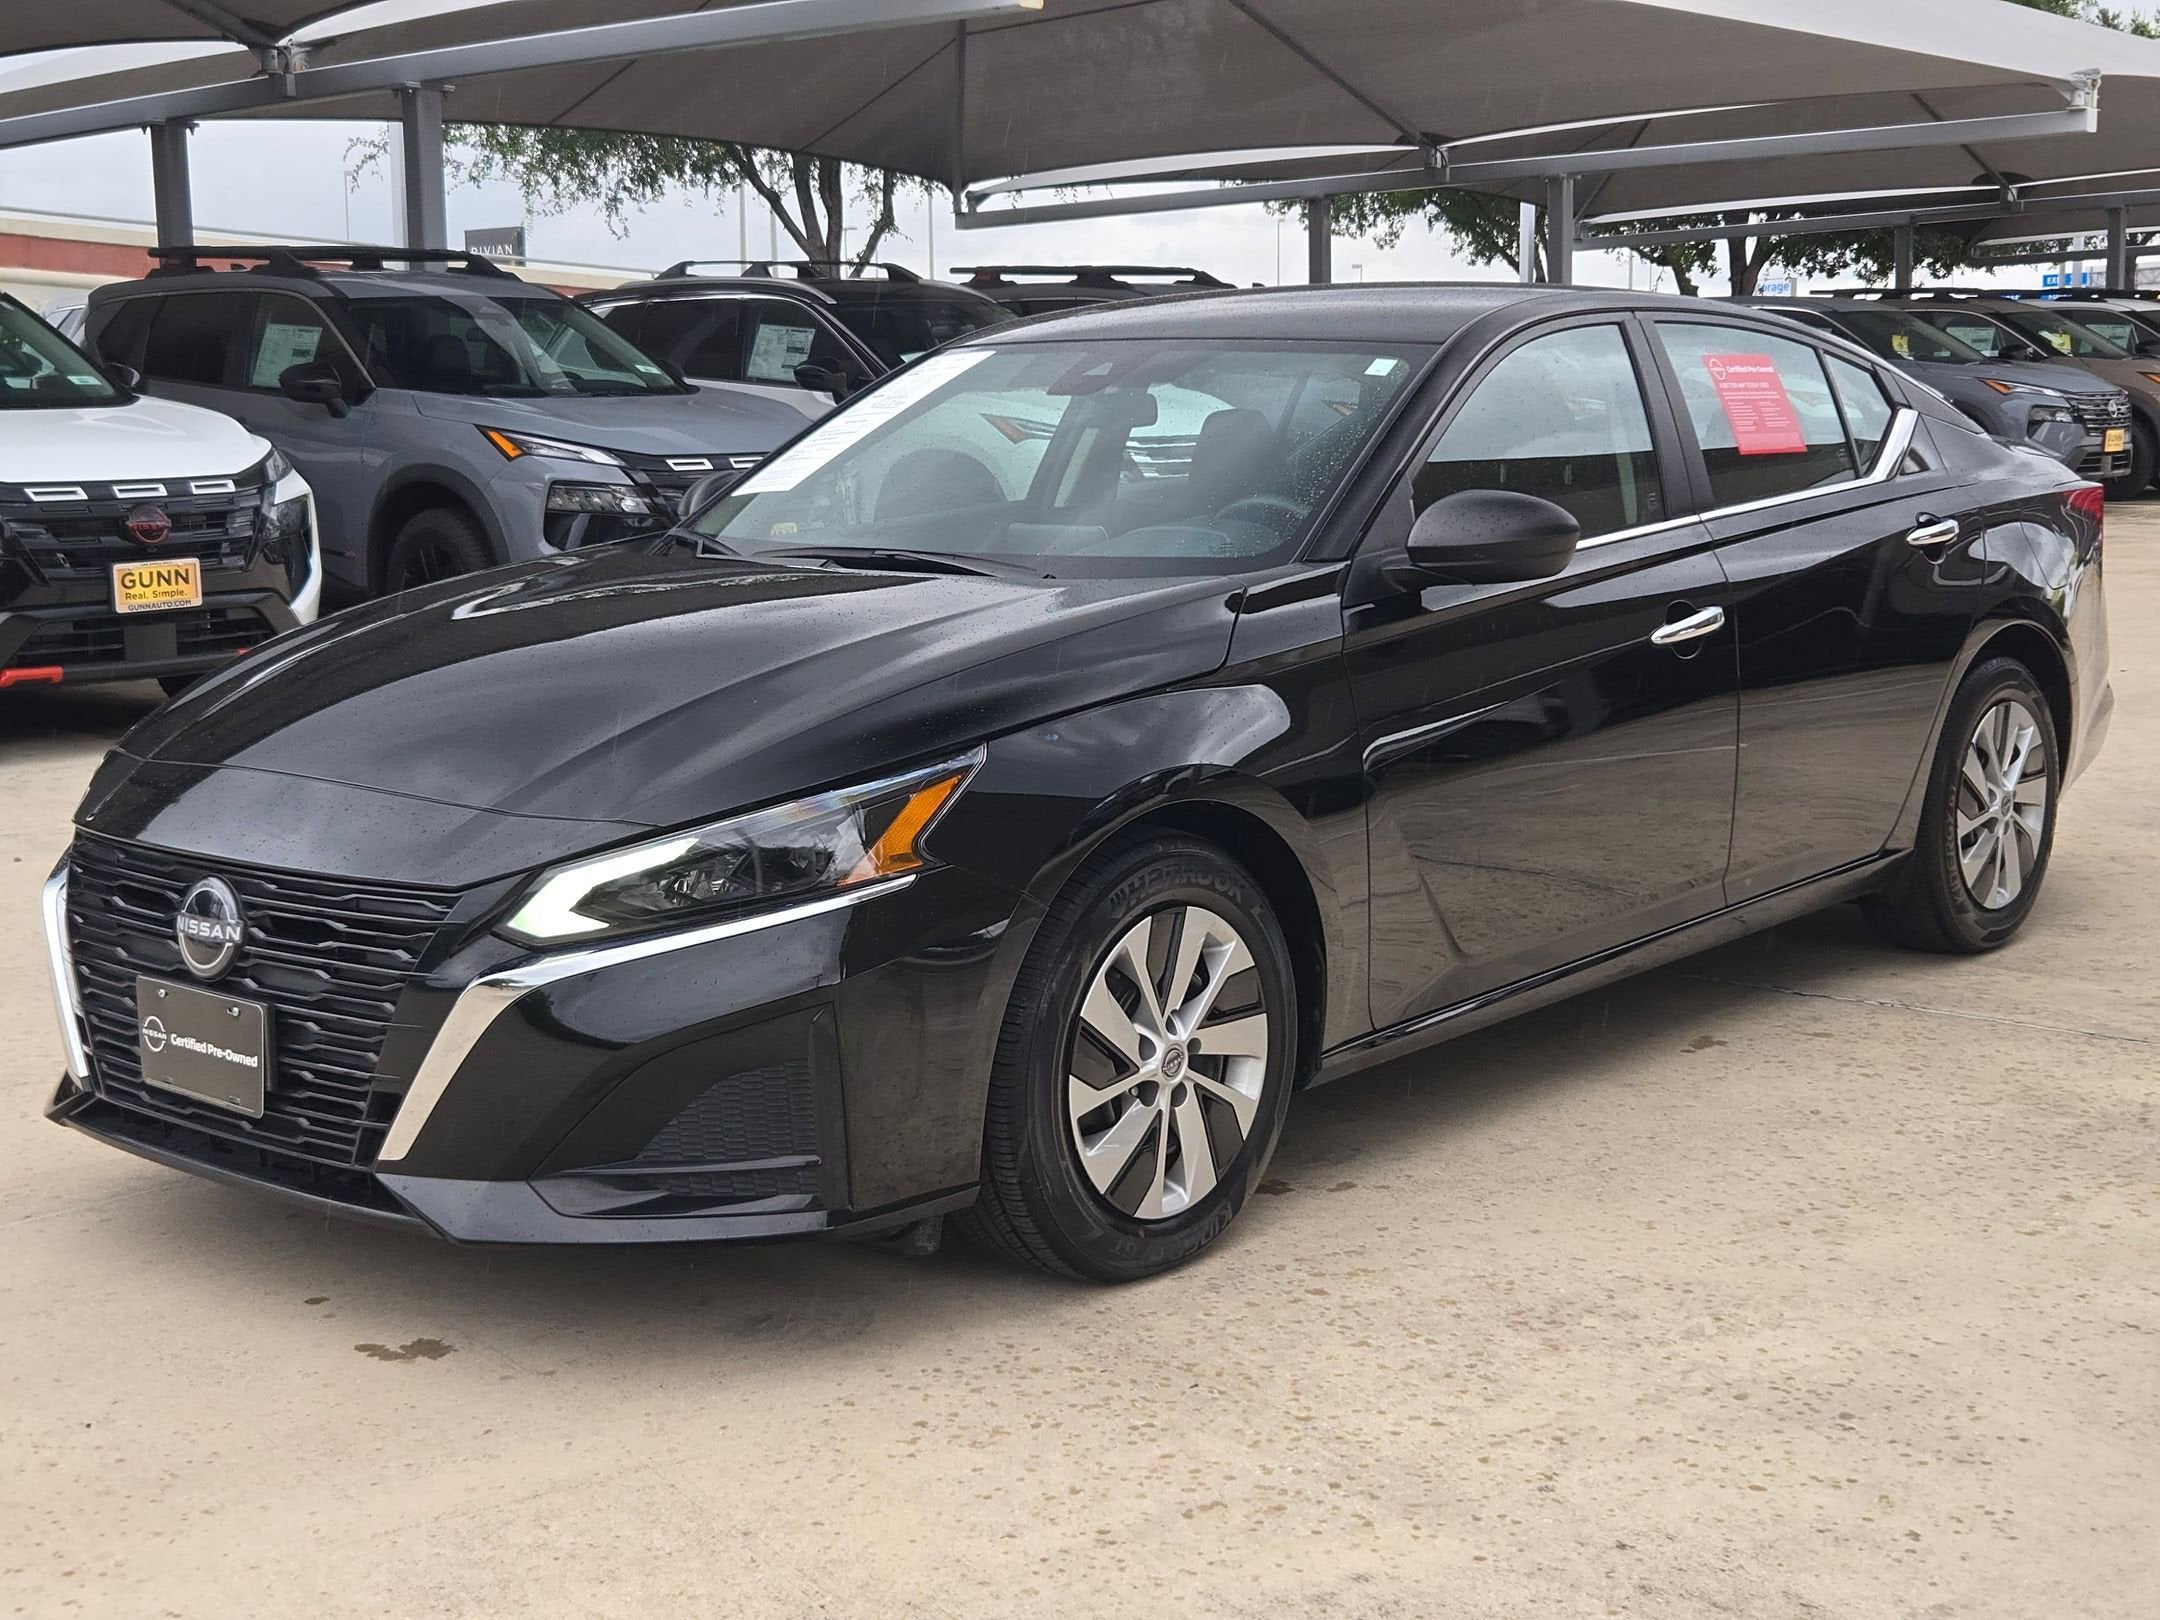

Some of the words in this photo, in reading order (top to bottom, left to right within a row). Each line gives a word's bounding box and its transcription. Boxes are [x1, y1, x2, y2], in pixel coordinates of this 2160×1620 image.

[471, 244, 513, 255] RIVIAN
[1762, 283, 1790, 294] orage
[121, 568, 190, 589] GUNN
[125, 592, 149, 600] Real.
[152, 588, 188, 598] Simple.
[128, 600, 191, 611] GUNNAUTO.COM
[177, 915, 241, 942] NISSAN
[143, 1028, 167, 1040] NISSAN
[171, 1033, 206, 1054] Certified
[208, 1045, 258, 1067] Pre-Owned
